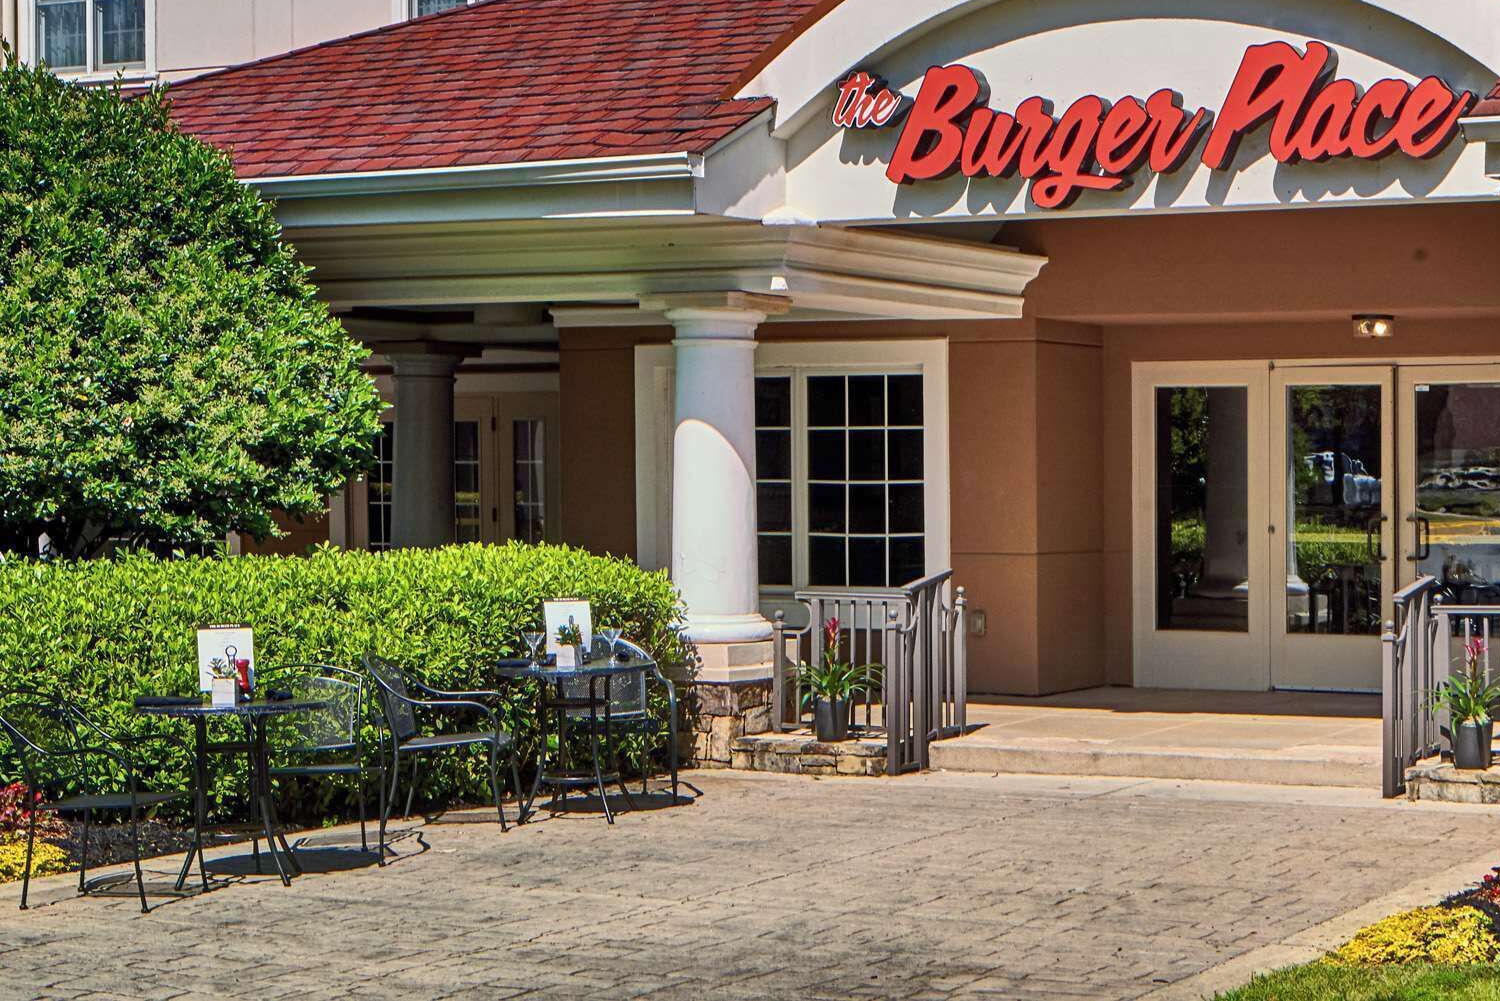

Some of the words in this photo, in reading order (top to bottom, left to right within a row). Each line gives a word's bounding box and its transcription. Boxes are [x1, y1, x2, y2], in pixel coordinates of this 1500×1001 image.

[832, 71, 902, 128] the
[885, 64, 1206, 209] Burger
[1200, 41, 1472, 170] Place
